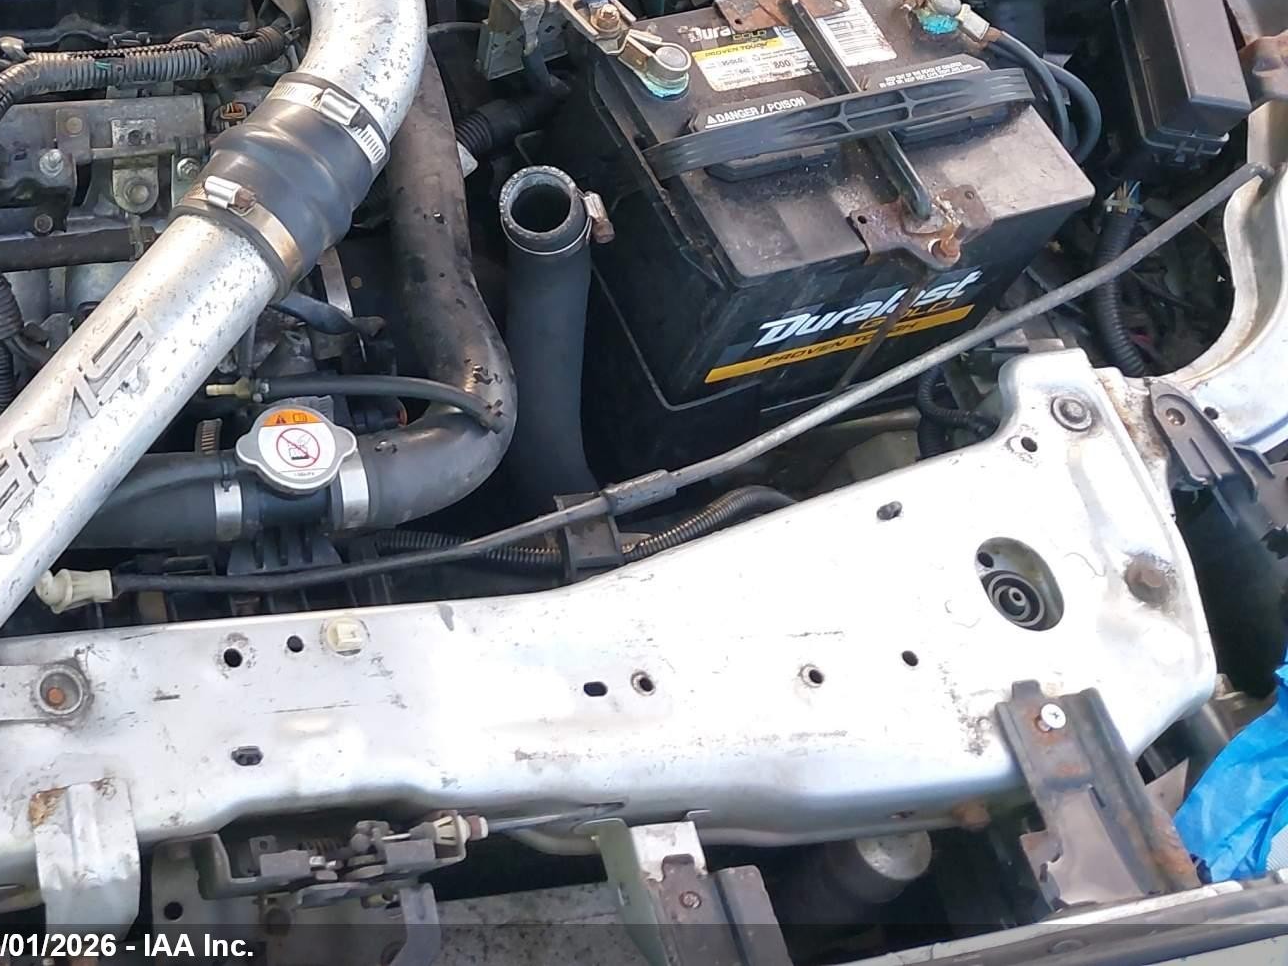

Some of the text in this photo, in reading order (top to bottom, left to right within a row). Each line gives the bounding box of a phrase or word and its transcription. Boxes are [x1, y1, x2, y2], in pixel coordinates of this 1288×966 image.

[677, 25, 735, 43] Dura
[772, 59, 792, 69] 800
[715, 106, 759, 124] DANGER
[767, 97, 807, 114] POISON
[859, 298, 956, 330] GLD
[763, 338, 848, 366] PROVEN
